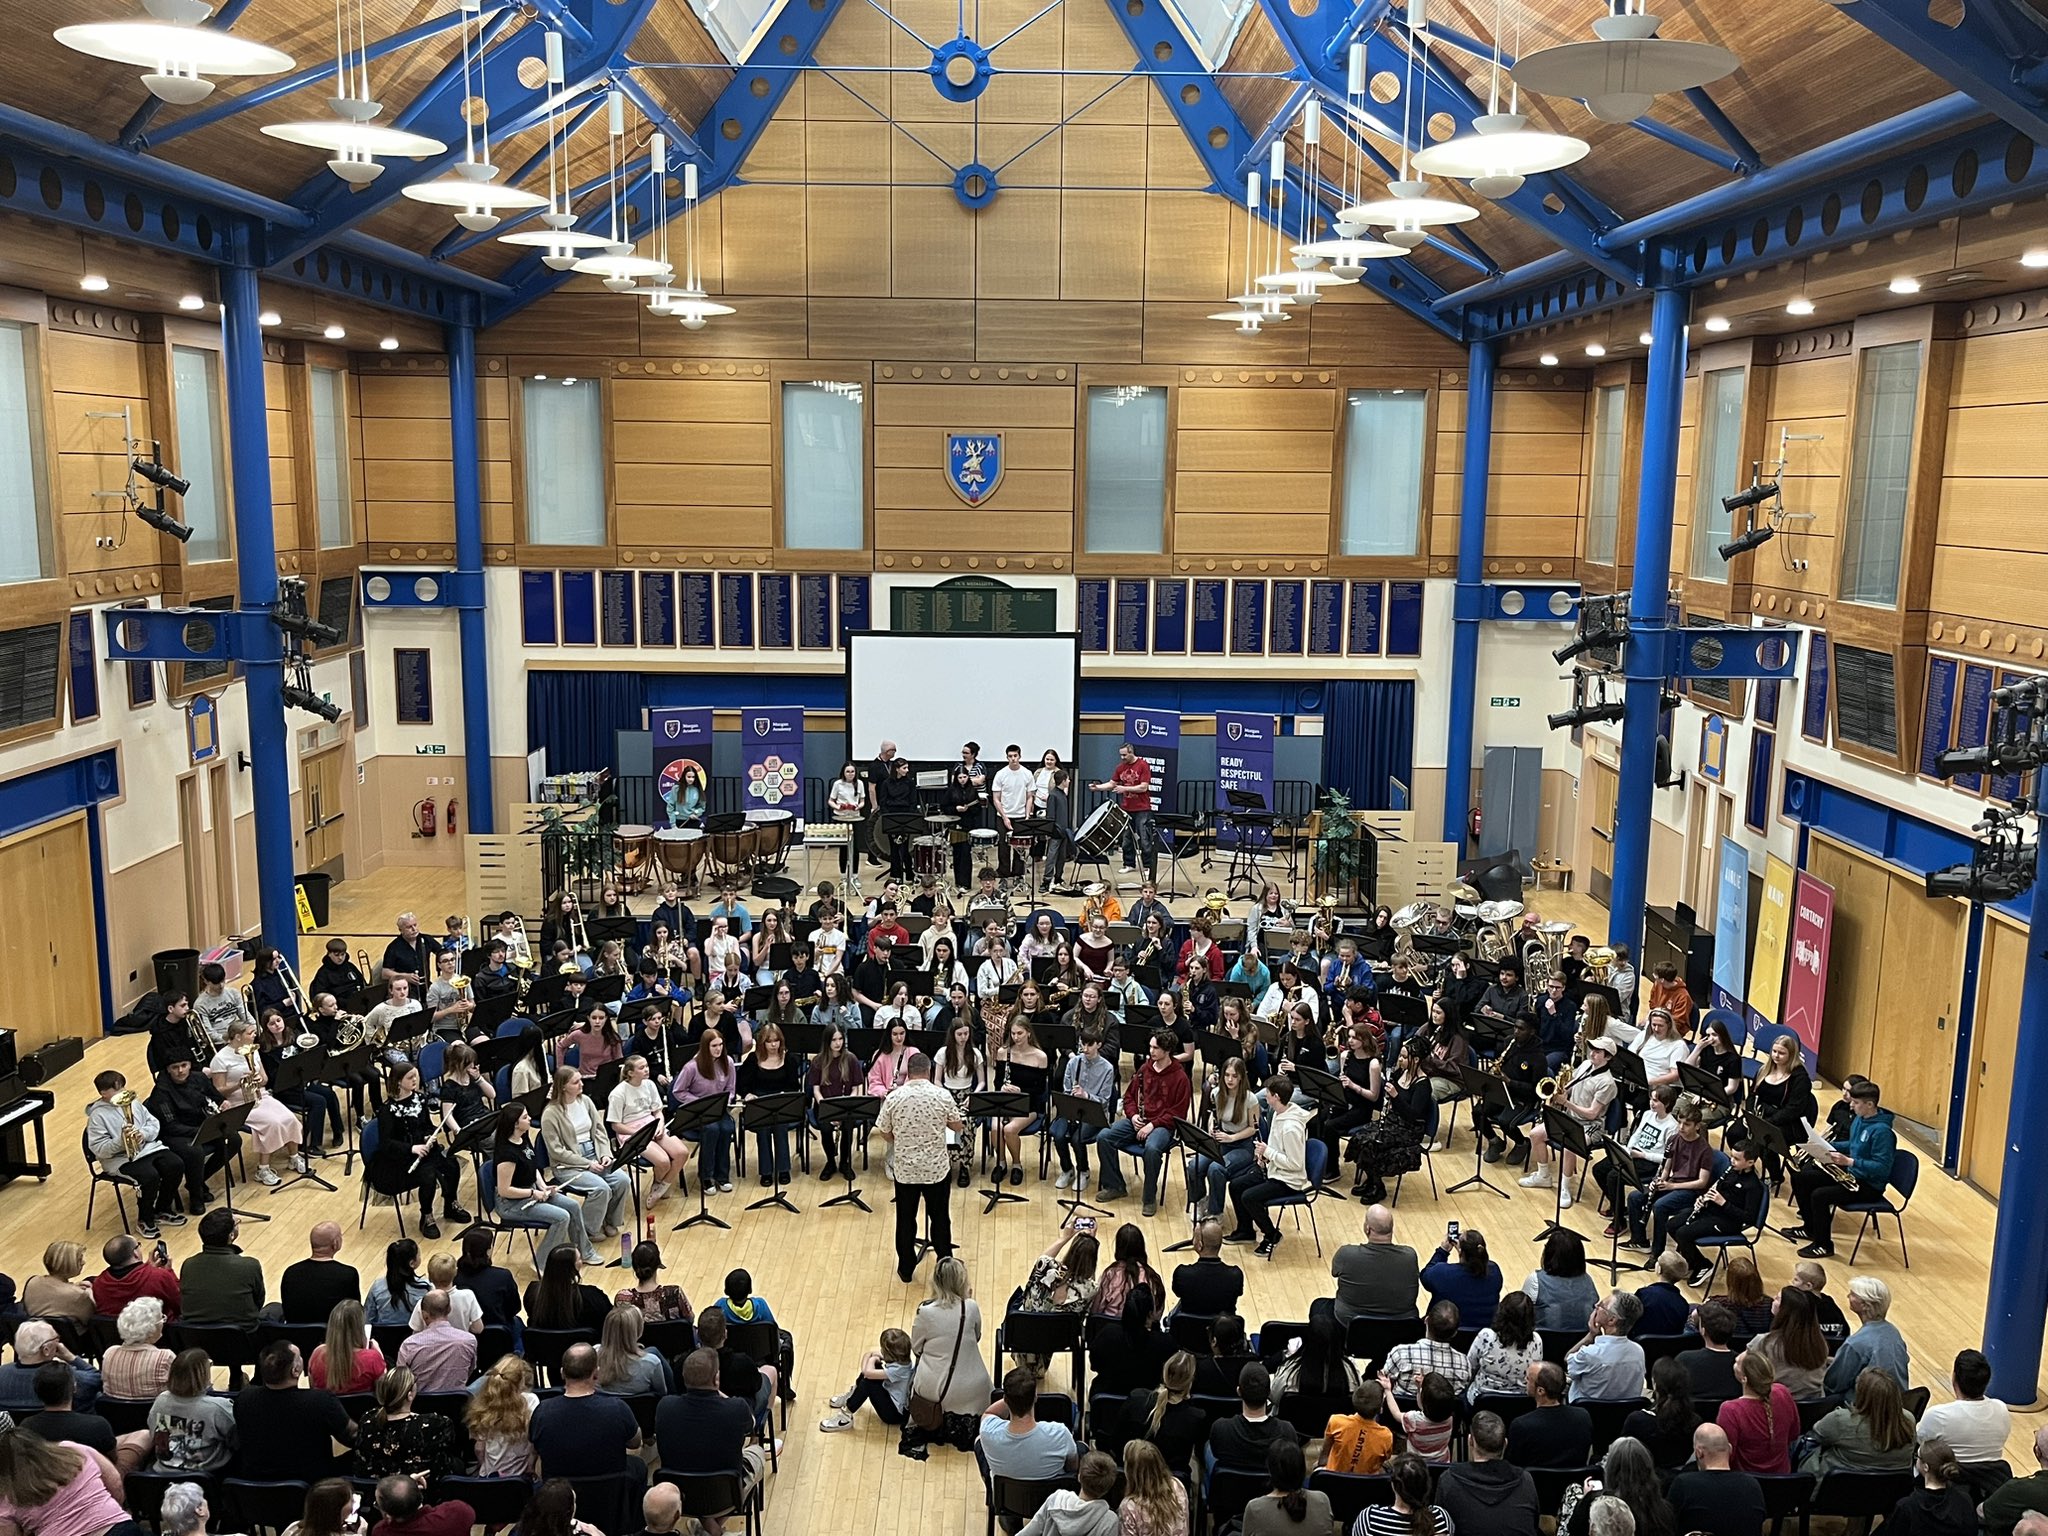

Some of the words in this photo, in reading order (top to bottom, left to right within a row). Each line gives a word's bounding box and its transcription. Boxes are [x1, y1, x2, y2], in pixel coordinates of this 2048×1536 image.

[1220, 757, 1244, 768] READY
[1220, 769, 1263, 781] RESPECTFUL
[1220, 780, 1238, 790] SAFE
[1725, 867, 1742, 890] AIRLIE
[1767, 884, 1785, 908] MAINS
[1800, 905, 1825, 929] CORTACHY
